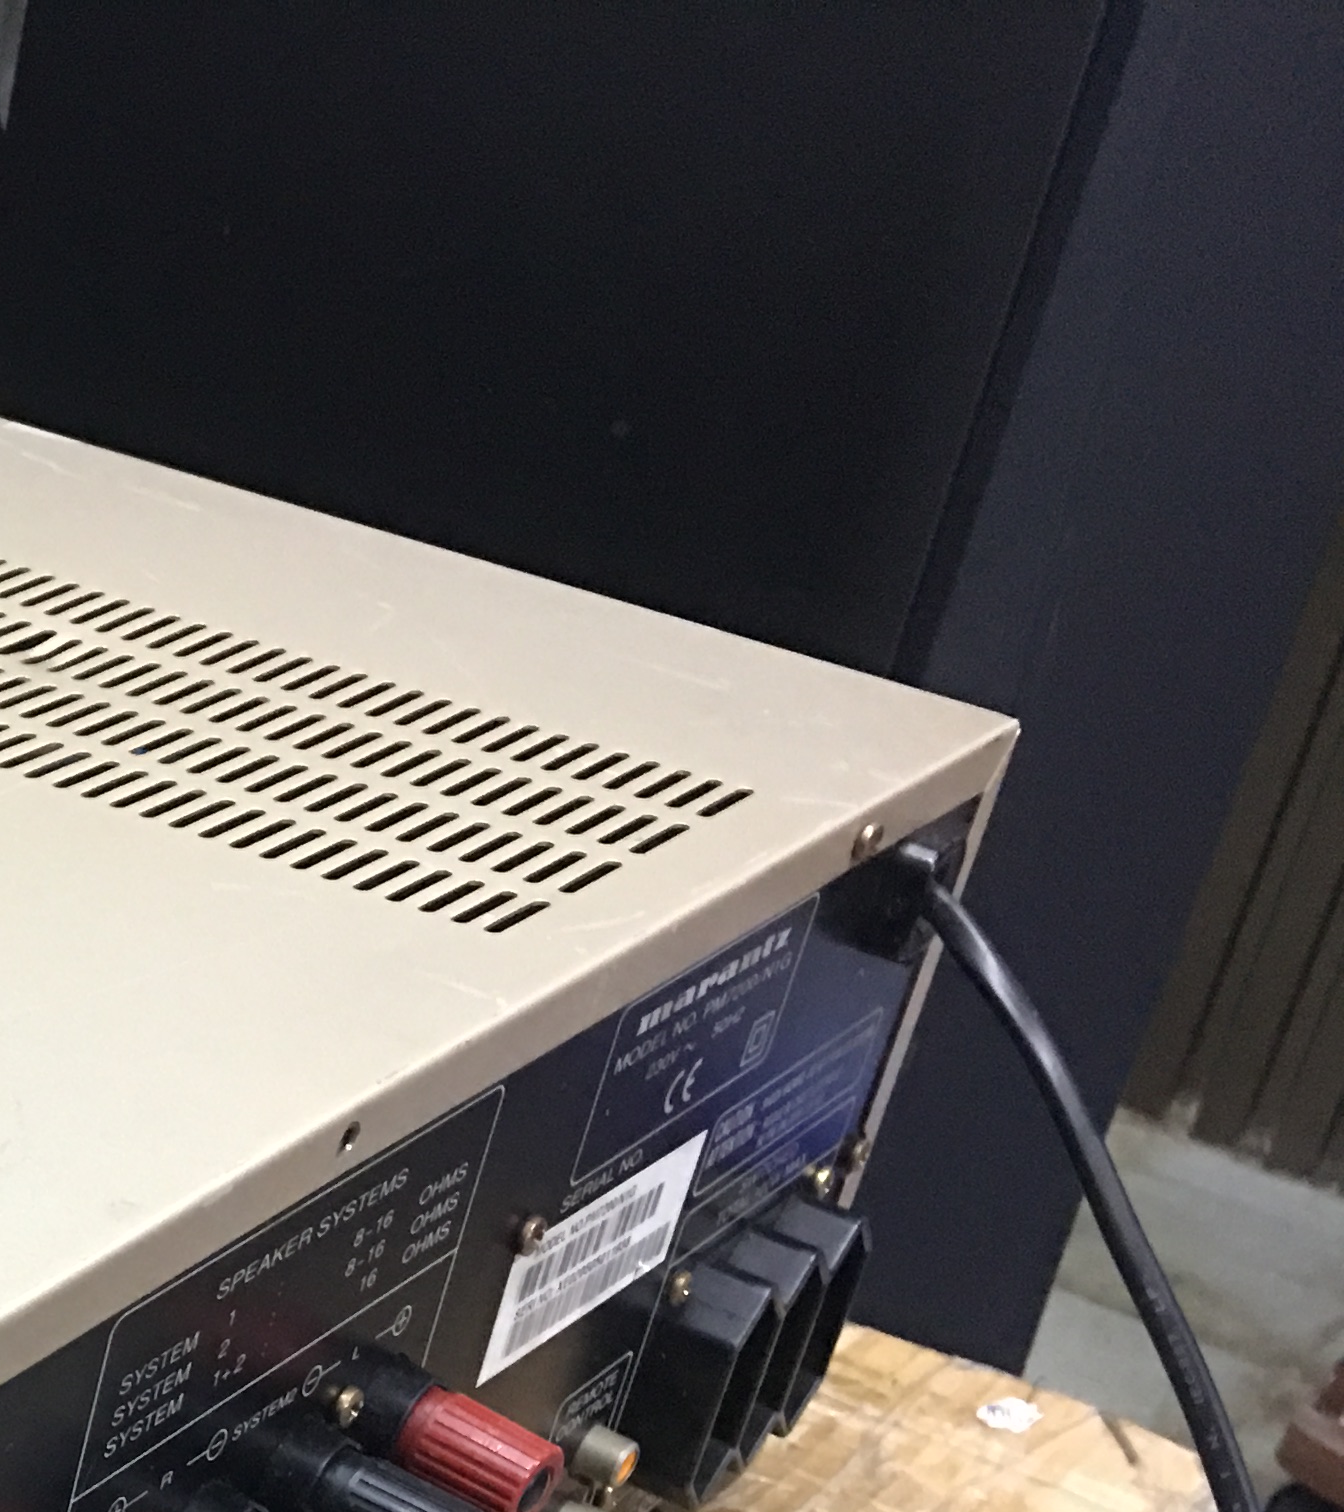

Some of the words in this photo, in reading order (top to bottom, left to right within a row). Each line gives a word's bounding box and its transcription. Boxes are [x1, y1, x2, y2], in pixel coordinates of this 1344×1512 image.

[636, 927, 793, 1037] marantz
[216, 1226, 314, 1301] SPEAKER
[316, 1167, 411, 1239] SYSTEMS
[559, 1167, 615, 1214] SERIAL
[103, 1392, 186, 1459] SYSTEM
[212, 1353, 247, 1387] 1+2
[358, 1267, 379, 1293] 16
[401, 1219, 453, 1265] OHMS
[111, 1362, 193, 1428] SYSTEM
[217, 1337, 232, 1360] 2
[344, 1239, 387, 1278] 8-16
[409, 1190, 461, 1236] OHMS
[118, 1330, 202, 1397] SYSTEM
[353, 1209, 396, 1248] 8-16
[418, 1161, 469, 1207] OHMS
[159, 1469, 175, 1490] R
